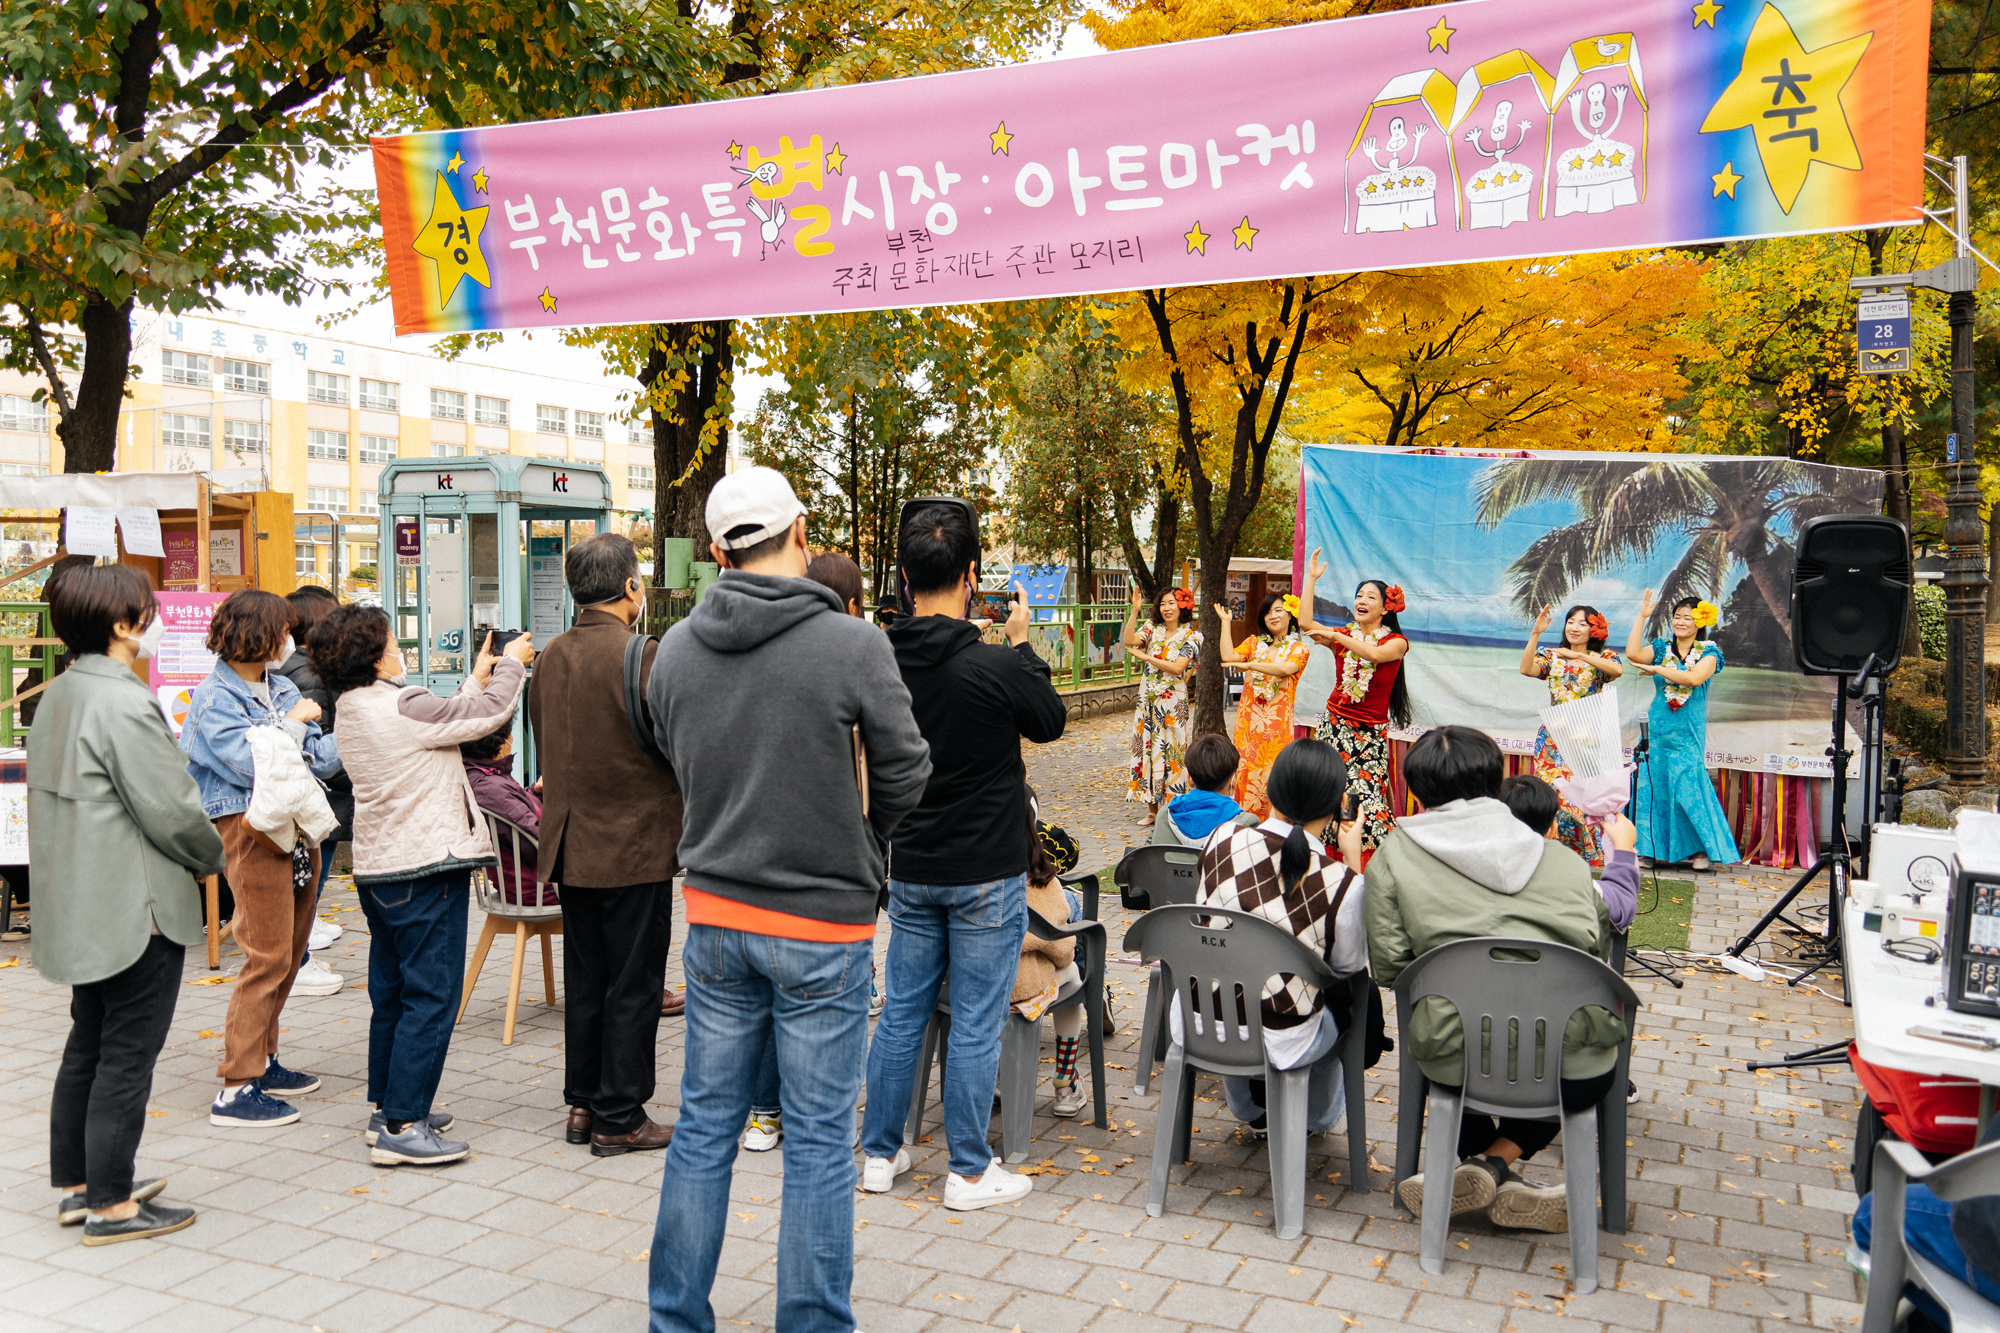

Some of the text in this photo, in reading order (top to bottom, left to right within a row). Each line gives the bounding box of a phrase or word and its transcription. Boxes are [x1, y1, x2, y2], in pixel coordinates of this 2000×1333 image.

[1760, 57, 1819, 152] 축
[1014, 119, 1316, 216] 아트마켓
[437, 215, 470, 265] 경
[885, 228, 935, 257] 부천
[832, 264, 879, 296] 주최
[1006, 243, 1057, 279] 주관
[1070, 235, 1145, 273] 모지리
[1874, 324, 1893, 338] 28
[437, 474, 453, 490] kt
[552, 472, 568, 493] kt
[399, 557, 420, 565] 공중전화
[441, 631, 459, 647] 5G
[1173, 868, 1193, 878] R.C.K
[1201, 935, 1227, 948] R.C.K
